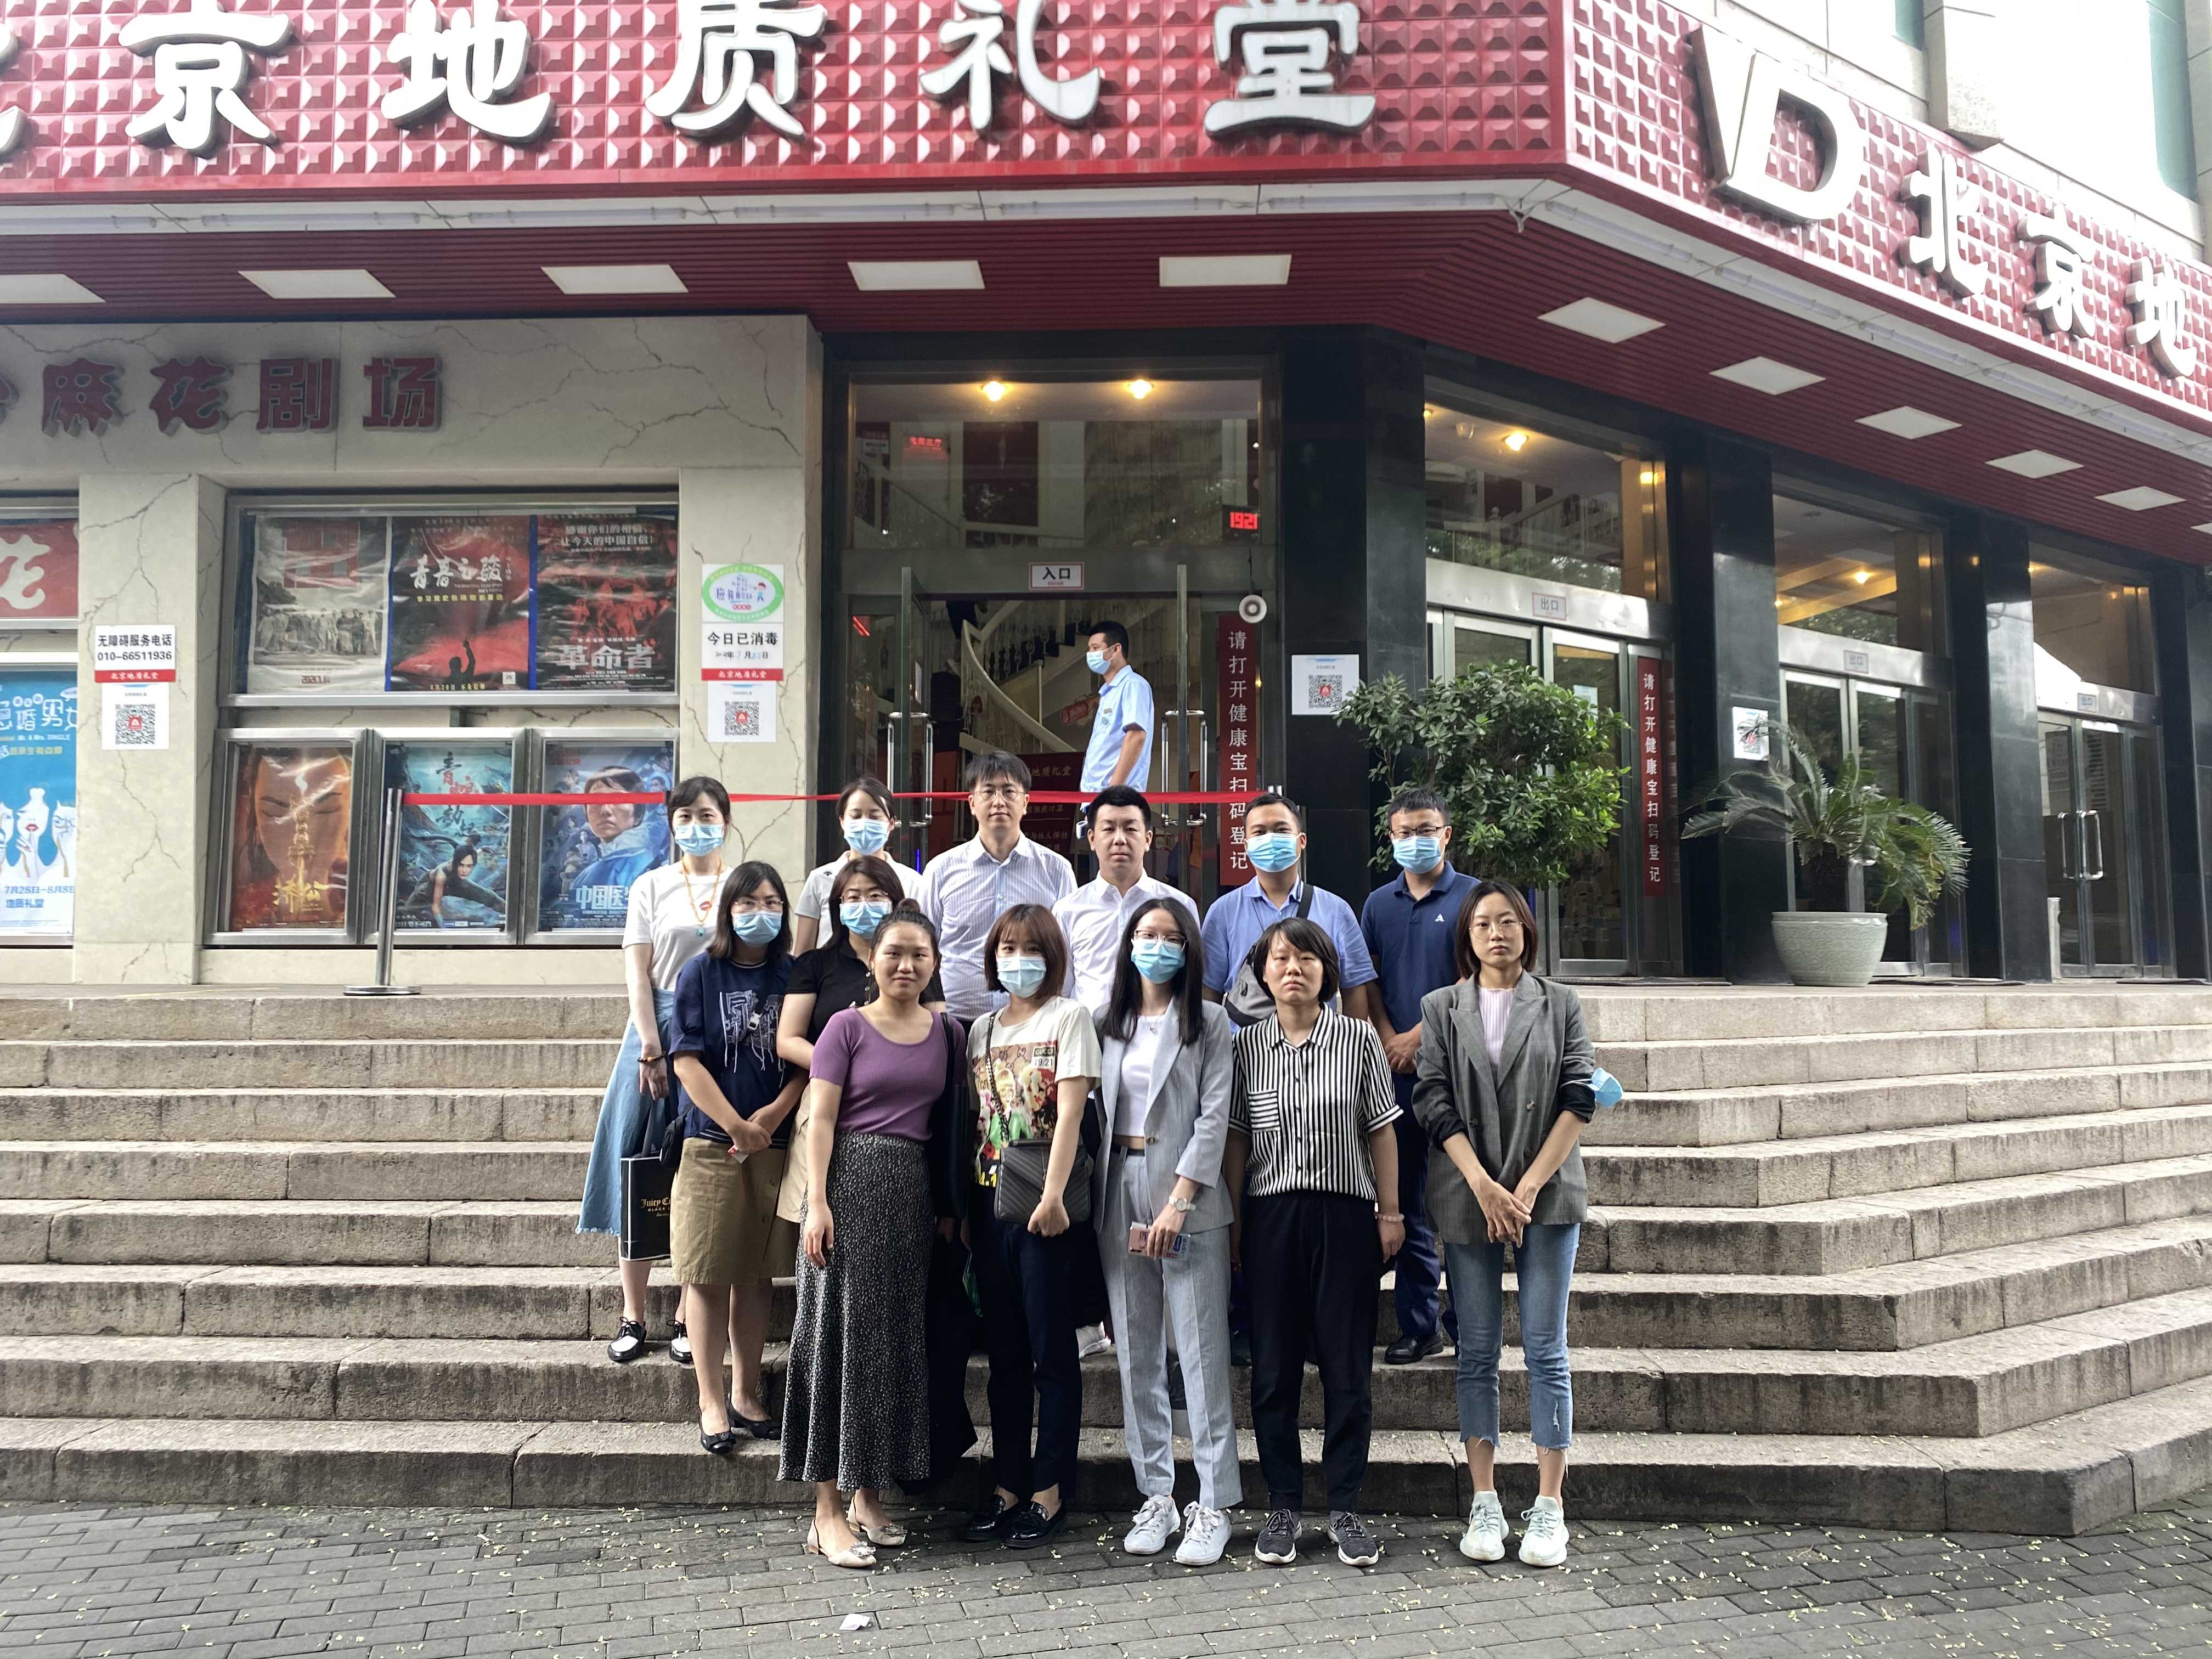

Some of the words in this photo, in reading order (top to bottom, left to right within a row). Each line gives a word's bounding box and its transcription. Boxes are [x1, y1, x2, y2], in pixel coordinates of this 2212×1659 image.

[0, 0, 1376, 151] 京地质礼堂
[0, 356, 441, 433] 麻花剧场
[1230, 511, 1258, 530] 1921
[1042, 567, 1070, 580] 入口
[1541, 596, 1559, 611] 出口
[97, 634, 172, 647] 无障碍服务电话
[707, 632, 778, 645] 今日已消毒
[97, 651, 172, 661] 010-66511936
[549, 644, 656, 670] 革命者
[1228, 630, 1249, 870] 请打开健康宝扫码登记
[1643, 673, 1661, 883] 请打开健康宝扫码登记
[641, 1199, 661, 1208] Juicy
